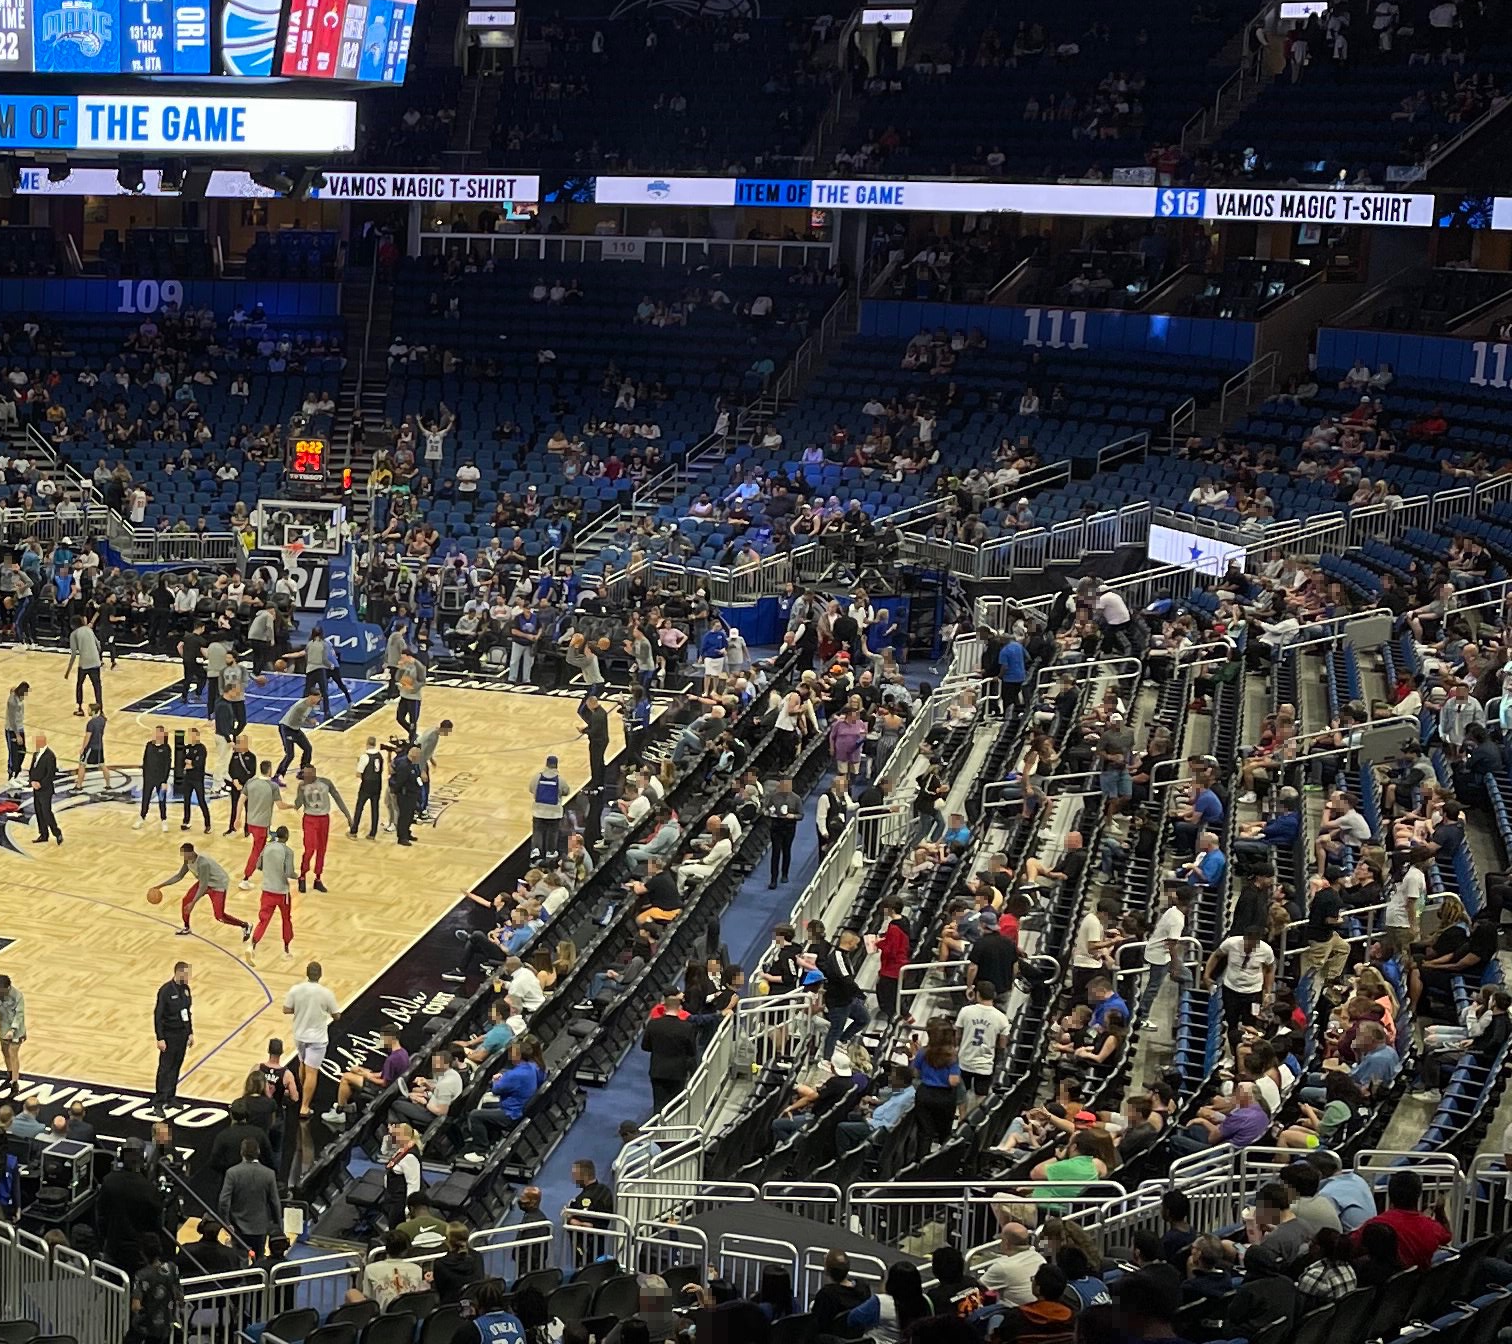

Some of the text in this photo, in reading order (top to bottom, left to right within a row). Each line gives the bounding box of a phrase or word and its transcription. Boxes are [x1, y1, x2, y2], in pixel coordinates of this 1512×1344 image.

[42, 9, 112, 41] MAGIC
[142, 3, 152, 25] L
[129, 25, 164, 42] 131-124
[175, 6, 206, 53] ORL
[136, 39, 157, 54] THU.
[145, 58, 162, 72] UTA
[30, 104, 70, 139] OF
[86, 105, 149, 141] THE
[162, 105, 246, 143] GAME
[329, 175, 517, 200] VAMOS MAGIC T-SHIRT
[739, 183, 904, 205] ITEM OF THE GAME
[1161, 189, 1412, 223] $15 VAMOS MAGIC T-SHIRT
[612, 242, 635, 254] 110
[117, 279, 184, 314] 109
[1022, 308, 1088, 349] 111
[1470, 340, 1512, 389] 11
[294, 452, 321, 473] 24
[421, 991, 456, 1015] COURT
[972, 1028, 985, 1047] 5
